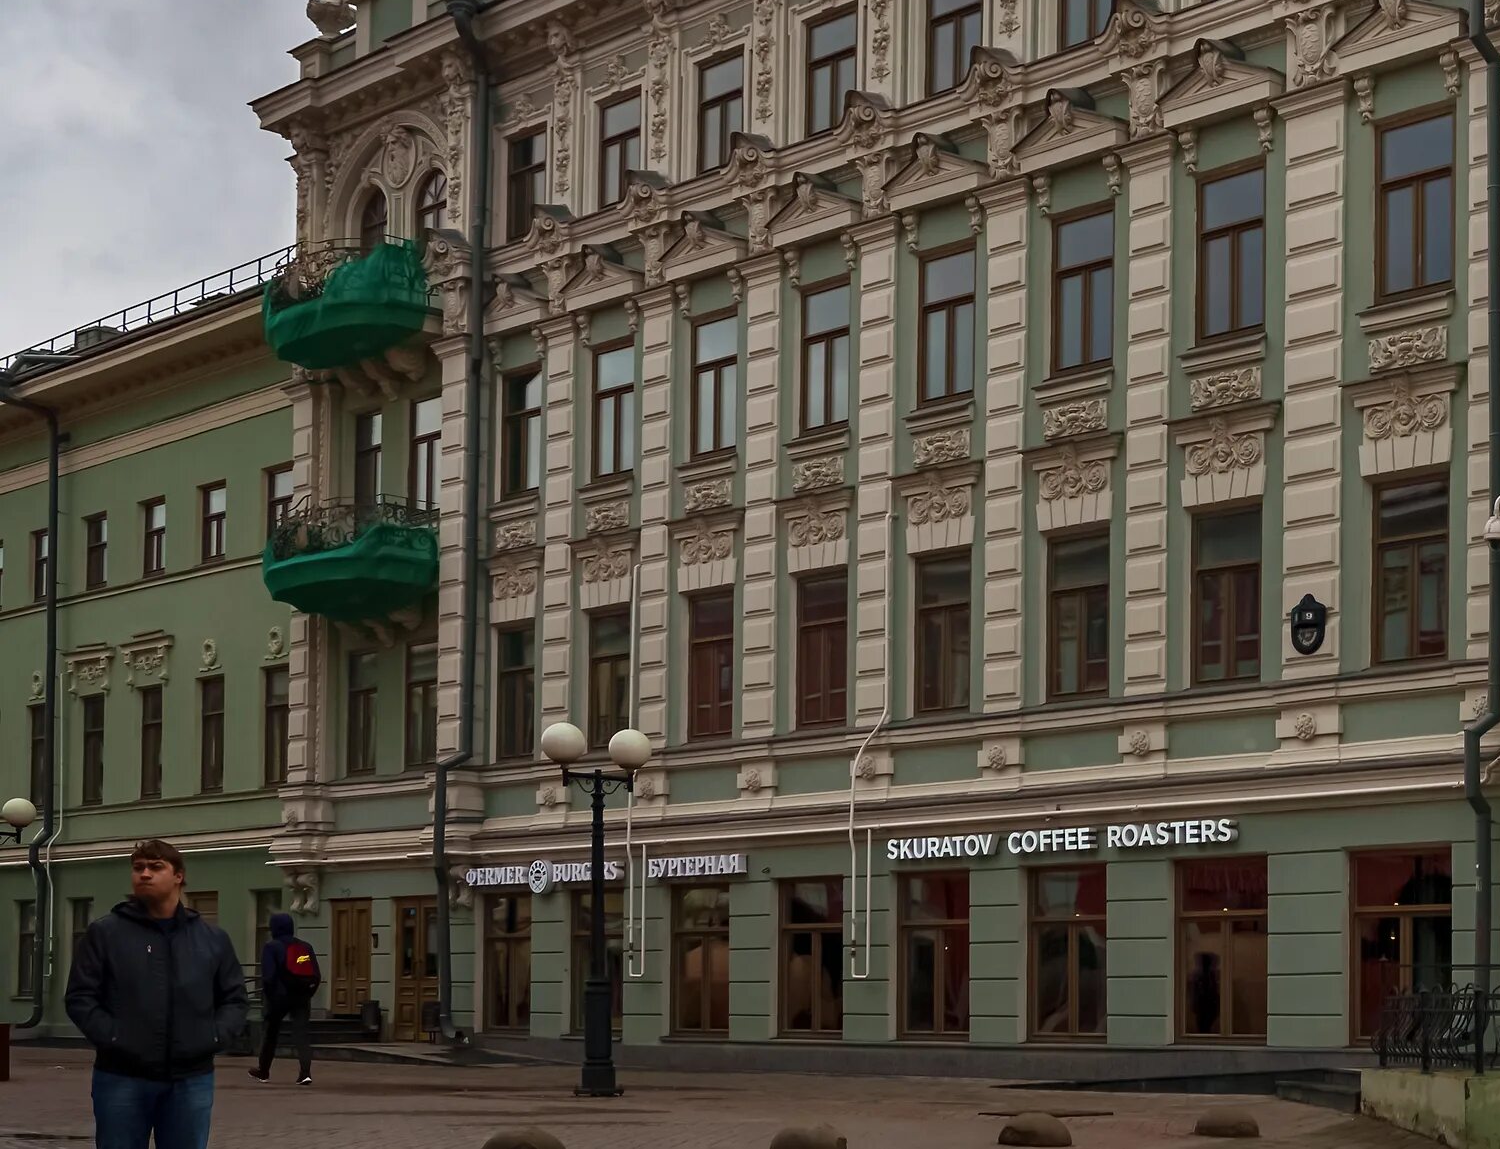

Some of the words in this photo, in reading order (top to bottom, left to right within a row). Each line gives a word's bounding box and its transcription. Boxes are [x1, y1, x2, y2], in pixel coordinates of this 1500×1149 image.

[886, 833, 995, 860] SKURATOV
[1007, 827, 1092, 854] COFFEE
[1106, 818, 1233, 848] ROASTERS
[552, 861, 618, 883] BURGRS
[647, 853, 741, 878] БУРГЕРНАЯ
